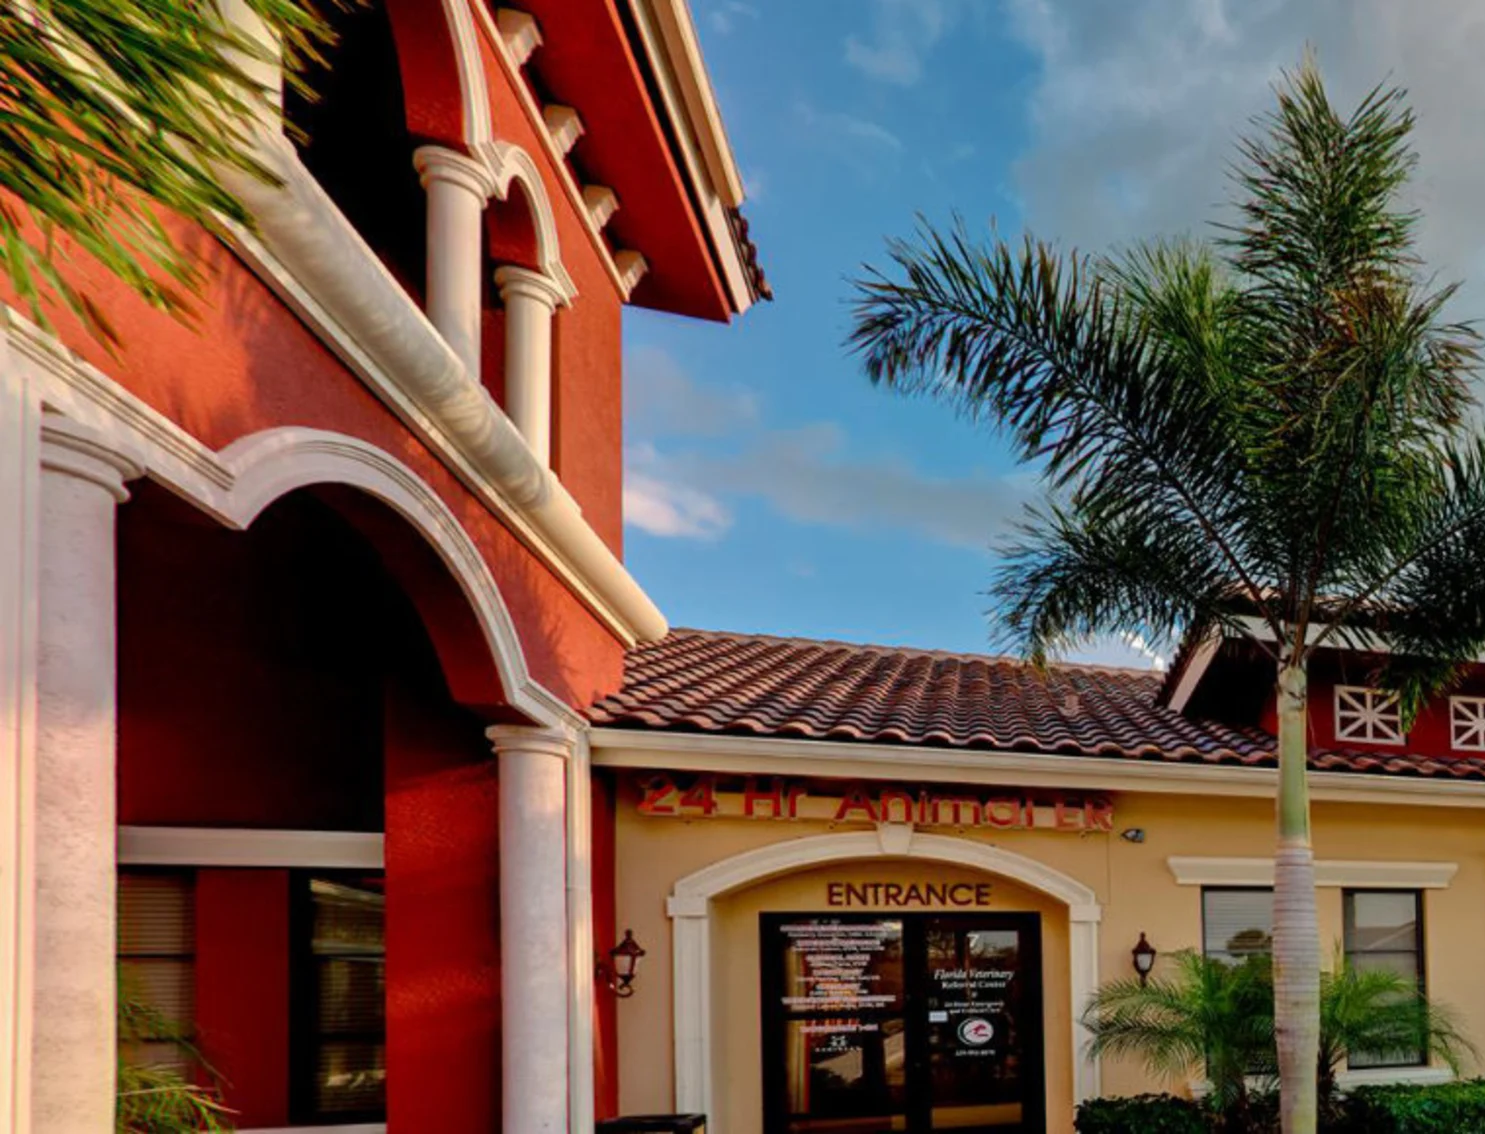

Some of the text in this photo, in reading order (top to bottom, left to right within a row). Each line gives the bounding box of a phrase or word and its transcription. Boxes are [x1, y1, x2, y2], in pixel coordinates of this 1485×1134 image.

[635, 774, 1114, 832] 24 Hr Animal ER
[827, 882, 991, 906] ENTRANCE
[966, 933, 979, 948] 7
